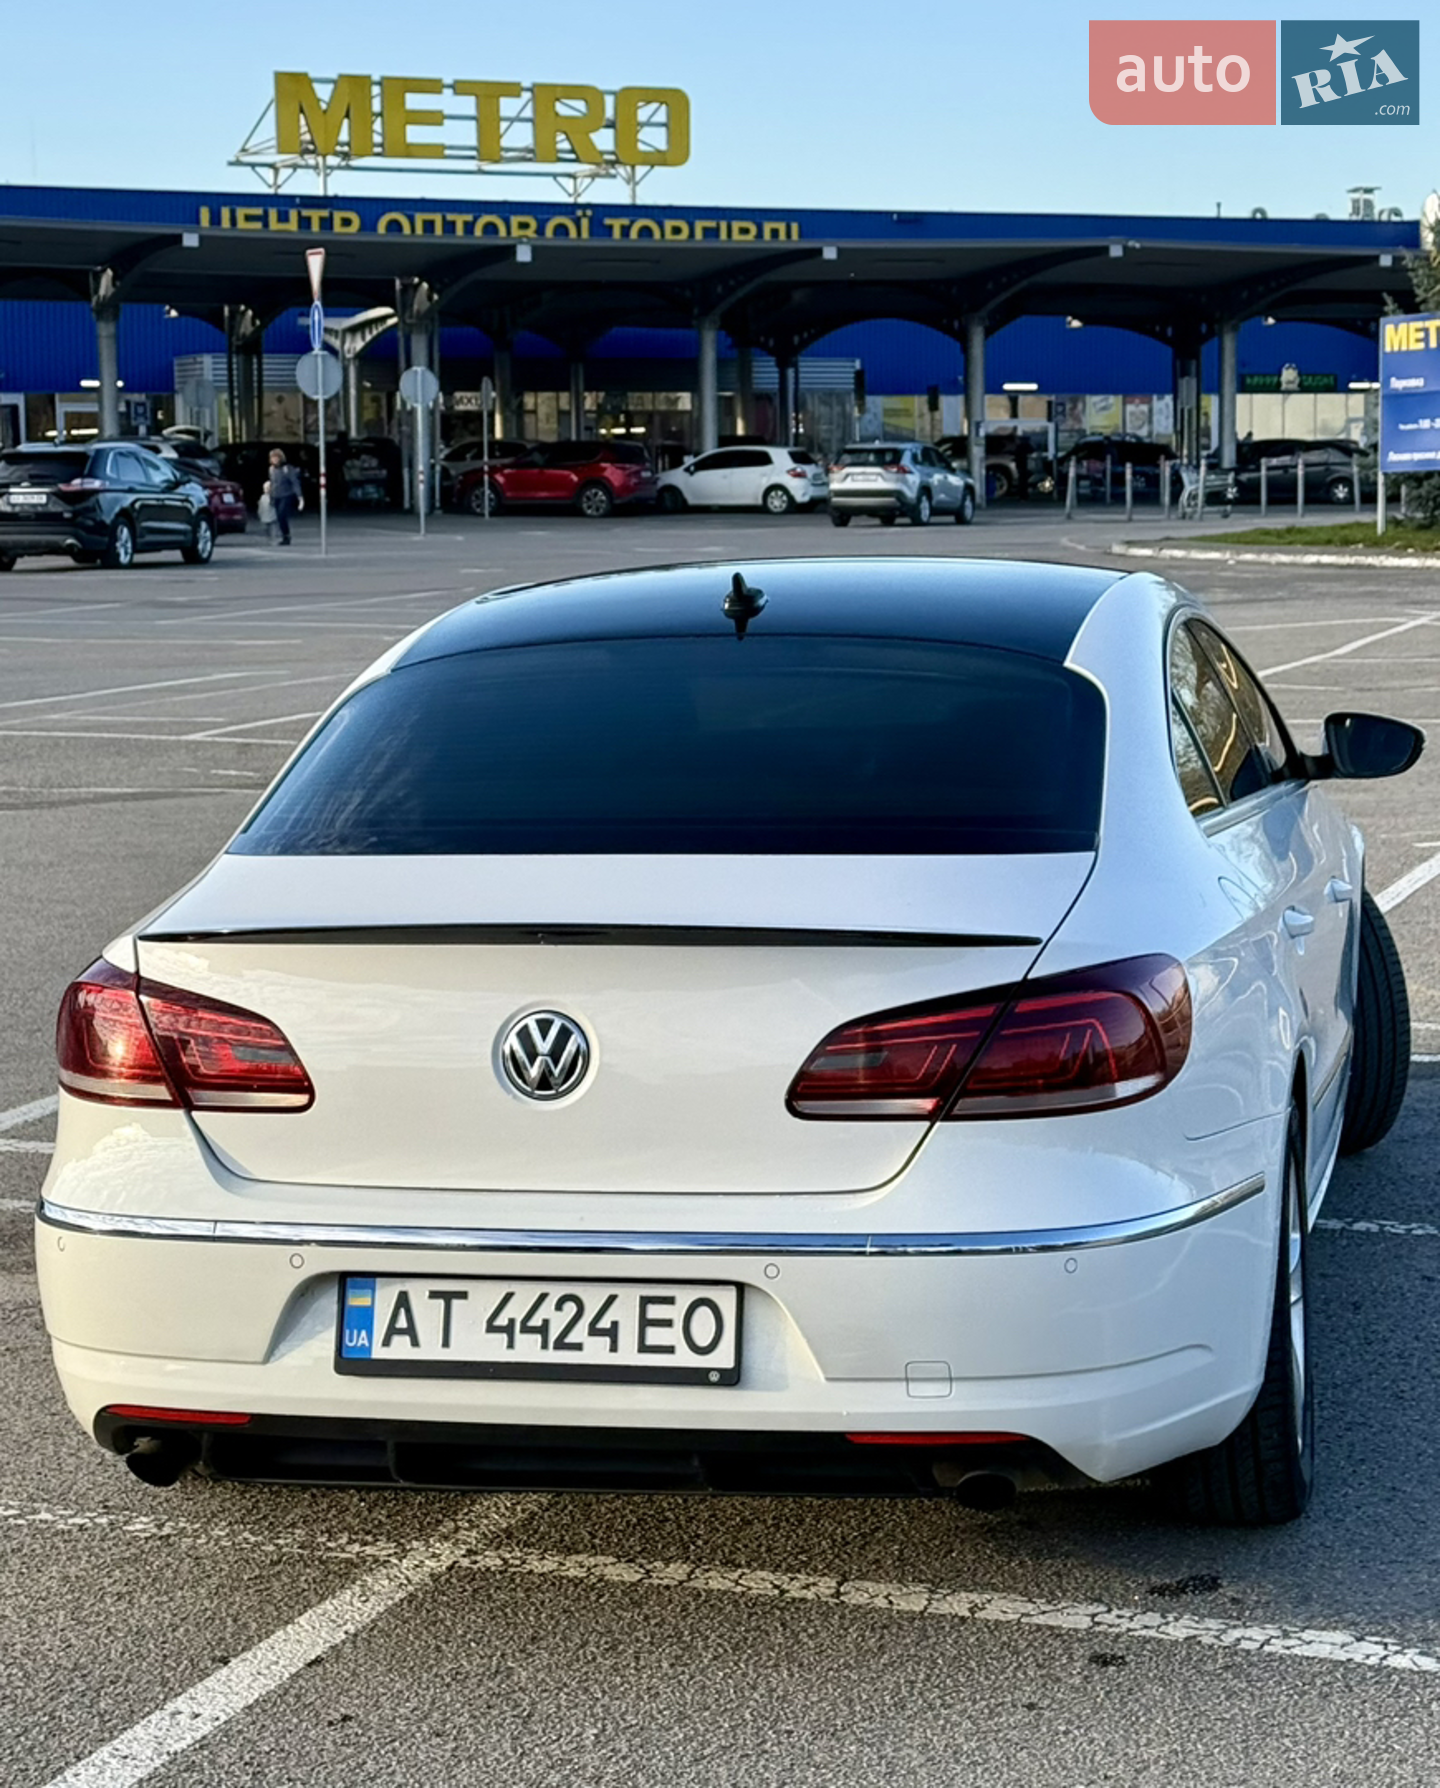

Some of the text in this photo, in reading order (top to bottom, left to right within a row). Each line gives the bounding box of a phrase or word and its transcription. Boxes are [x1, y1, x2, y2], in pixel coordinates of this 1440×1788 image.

[274, 71, 690, 167] METRO
[345, 1328, 370, 1347] UA
[381, 1289, 724, 1356] AT 4424 EO
